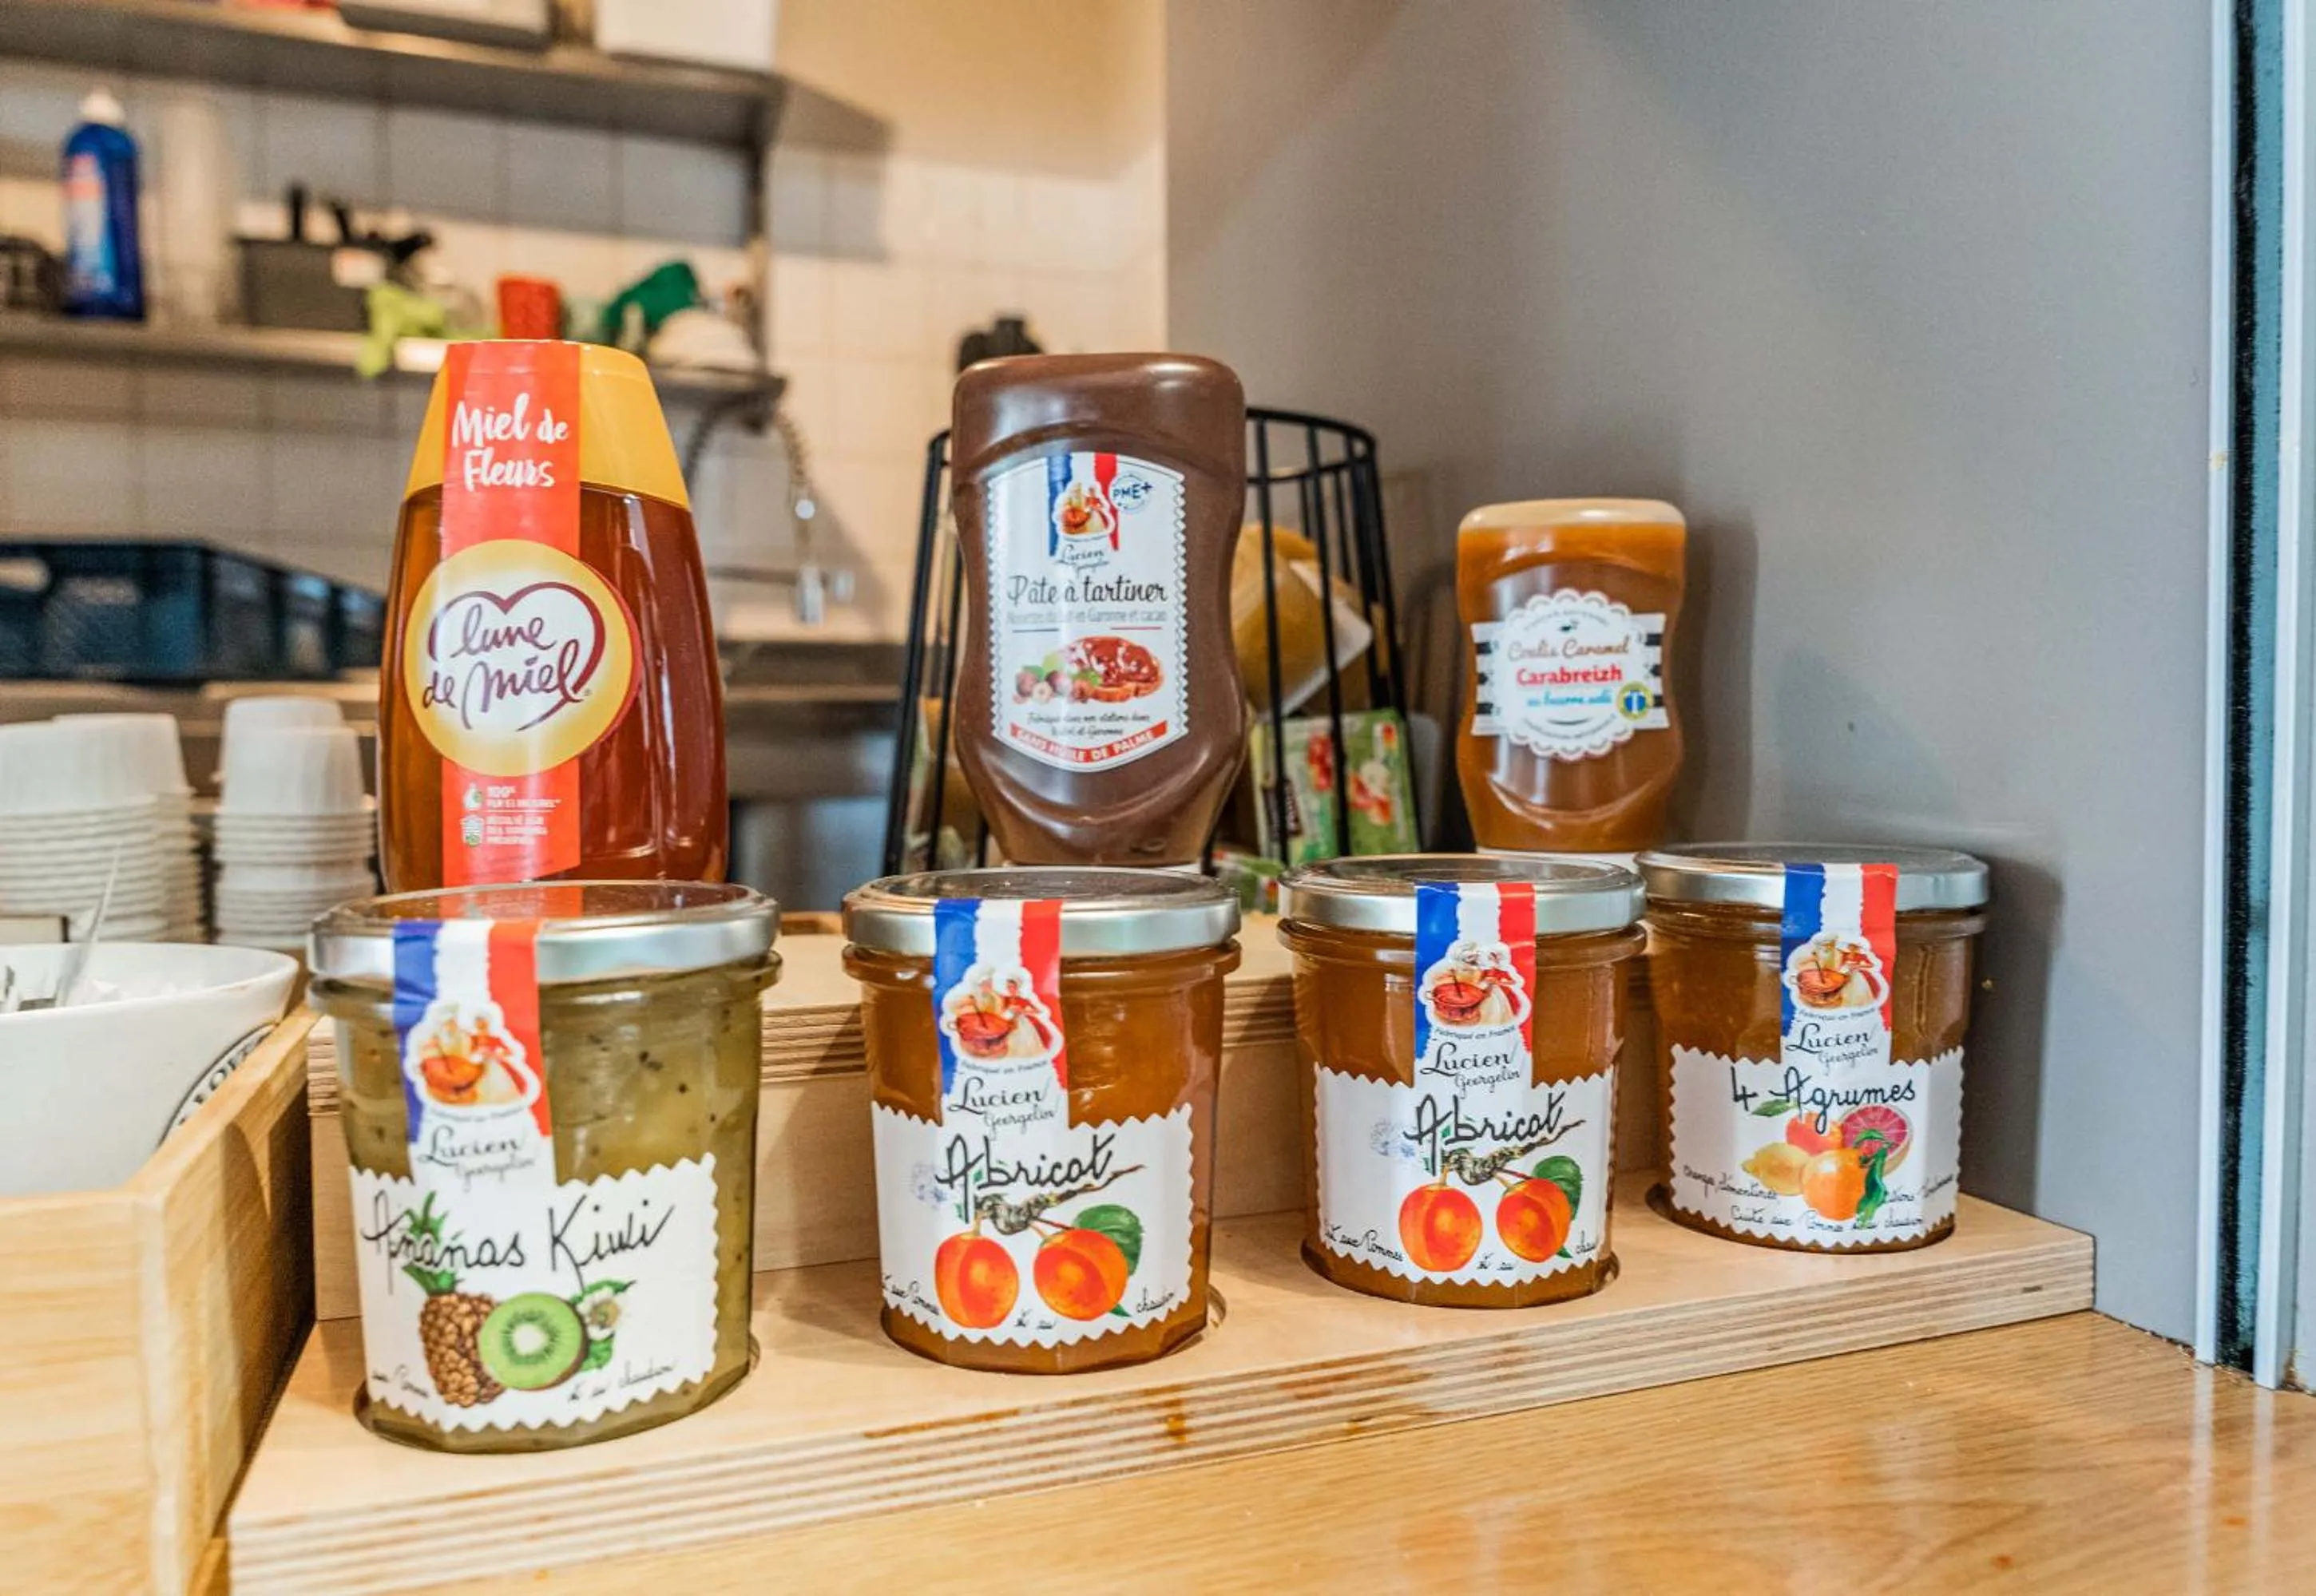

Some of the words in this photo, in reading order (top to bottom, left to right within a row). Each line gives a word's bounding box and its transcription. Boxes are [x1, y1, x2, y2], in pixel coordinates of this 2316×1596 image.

[451, 392, 530, 447] Miel
[536, 408, 569, 445] de
[463, 446, 557, 493] Fleurs
[1007, 575, 1057, 608] Pâte
[1064, 578, 1080, 603] à
[1082, 574, 1169, 603] tartiner
[1562, 634, 1631, 659] Caramel
[422, 671, 458, 709] de
[1516, 663, 1624, 687] Carabreizh
[1419, 1041, 1512, 1078] Lucien
[1785, 1023, 1870, 1055] Lucien
[947, 1075, 1044, 1115] Lucien
[1730, 1065, 1759, 1112] 4
[1768, 1065, 1917, 1135] Agrumes
[416, 1124, 521, 1167] Lucien
[1403, 1091, 1566, 1177] Abricot
[934, 1131, 1116, 1224] Abricot
[362, 1189, 526, 1295] Ananas
[547, 1194, 676, 1273] Kiwi
